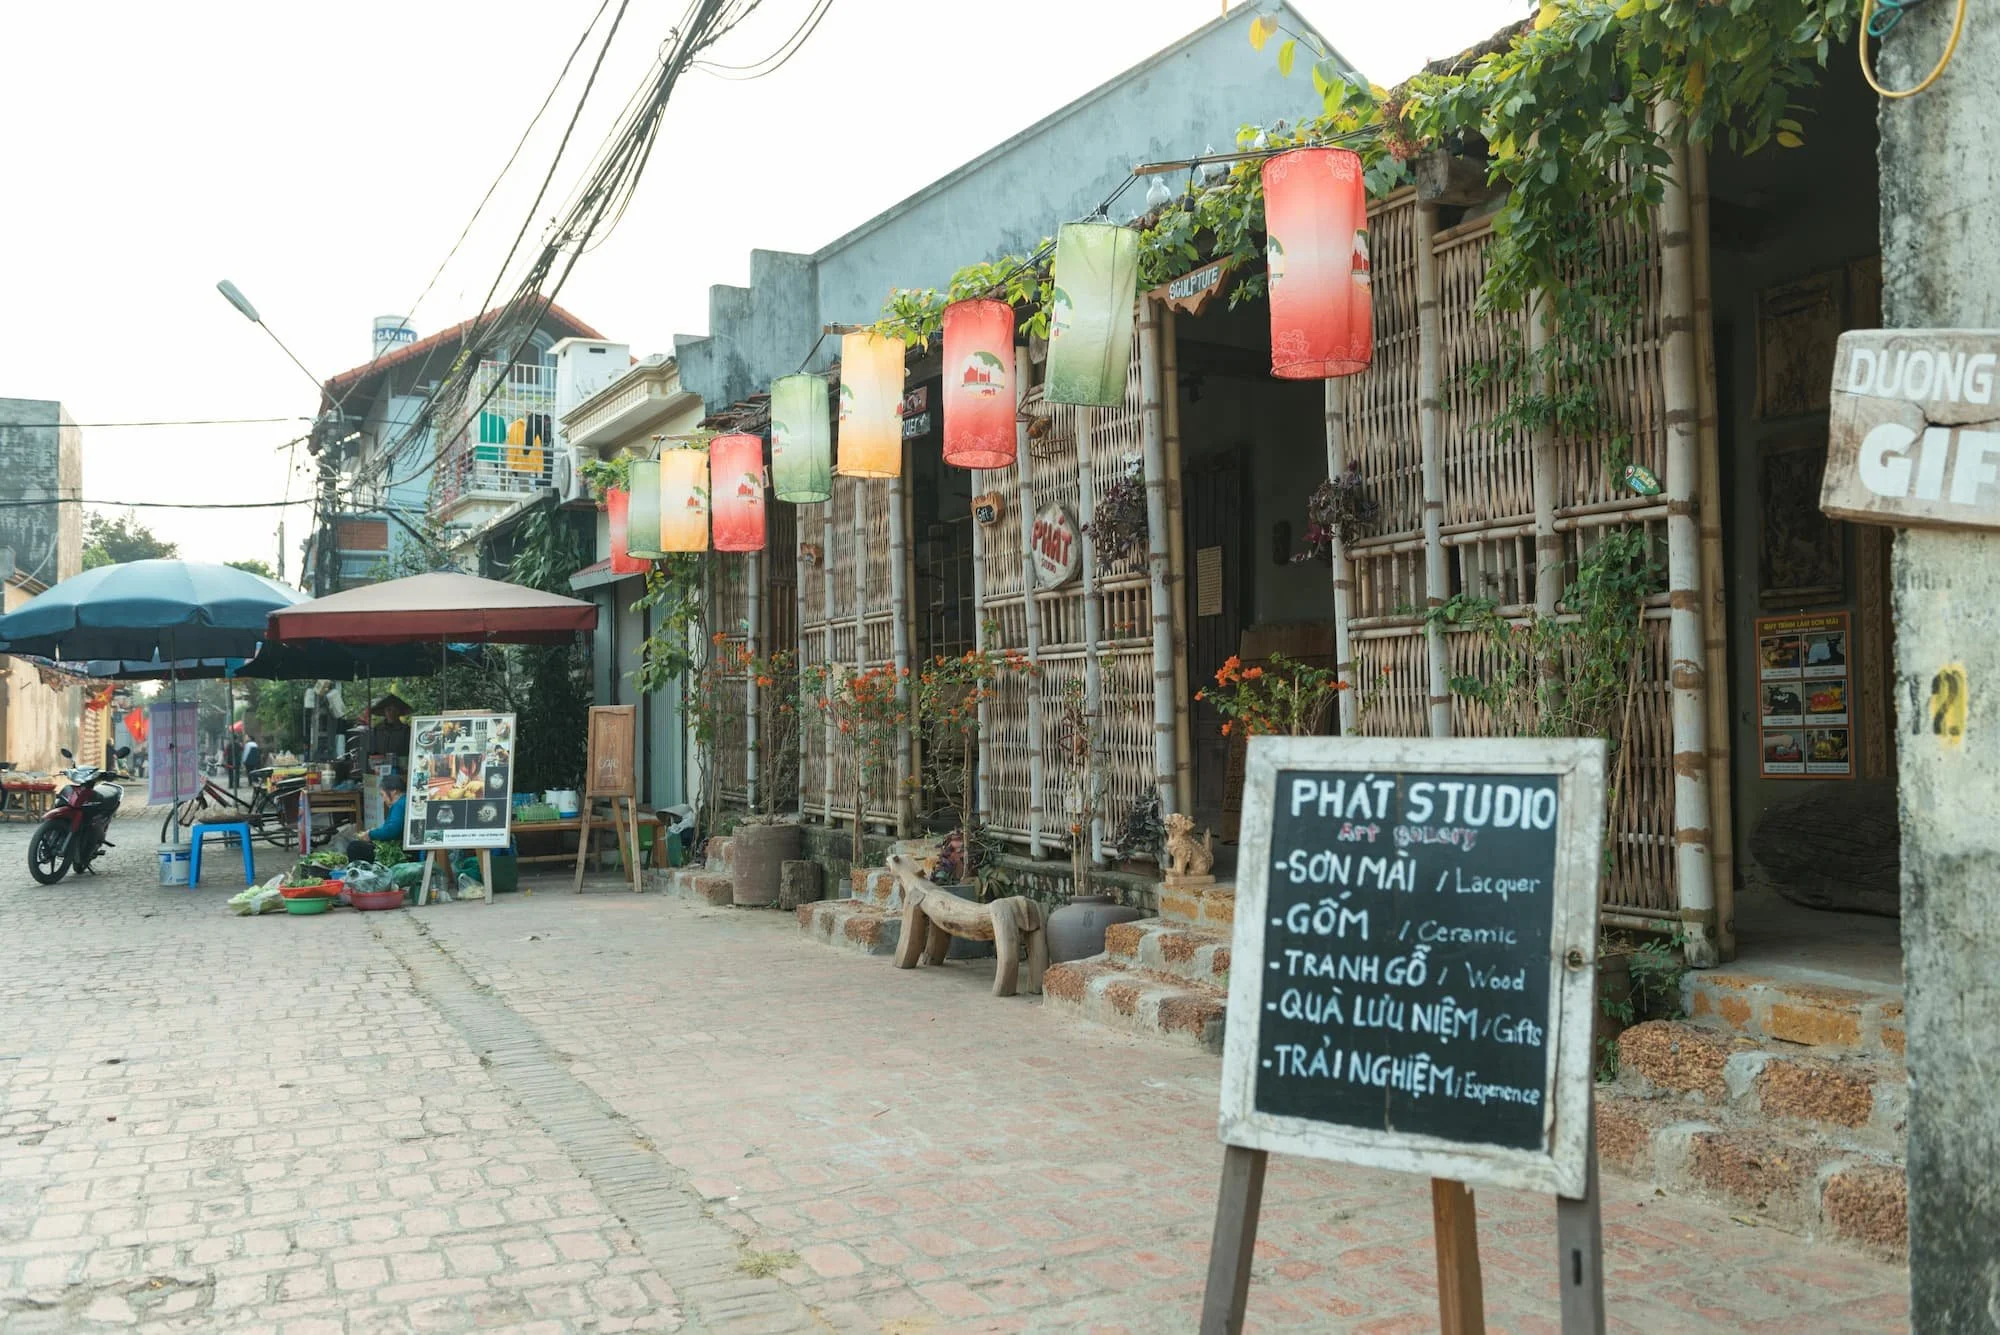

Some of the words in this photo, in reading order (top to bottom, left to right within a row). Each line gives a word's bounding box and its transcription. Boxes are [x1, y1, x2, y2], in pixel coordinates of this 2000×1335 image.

[1848, 348, 1997, 404] DUONG
[1291, 773, 1395, 820] PHÁT
[1406, 782, 1556, 830] STUDIO
[1337, 822, 1380, 844] Art
[1357, 850, 1416, 892] MÀI
[1456, 867, 1541, 902] Lacquer
[1418, 920, 1517, 945] Ceramic
[1384, 944, 1431, 987] GỖ
[1464, 961, 1525, 991] Wood
